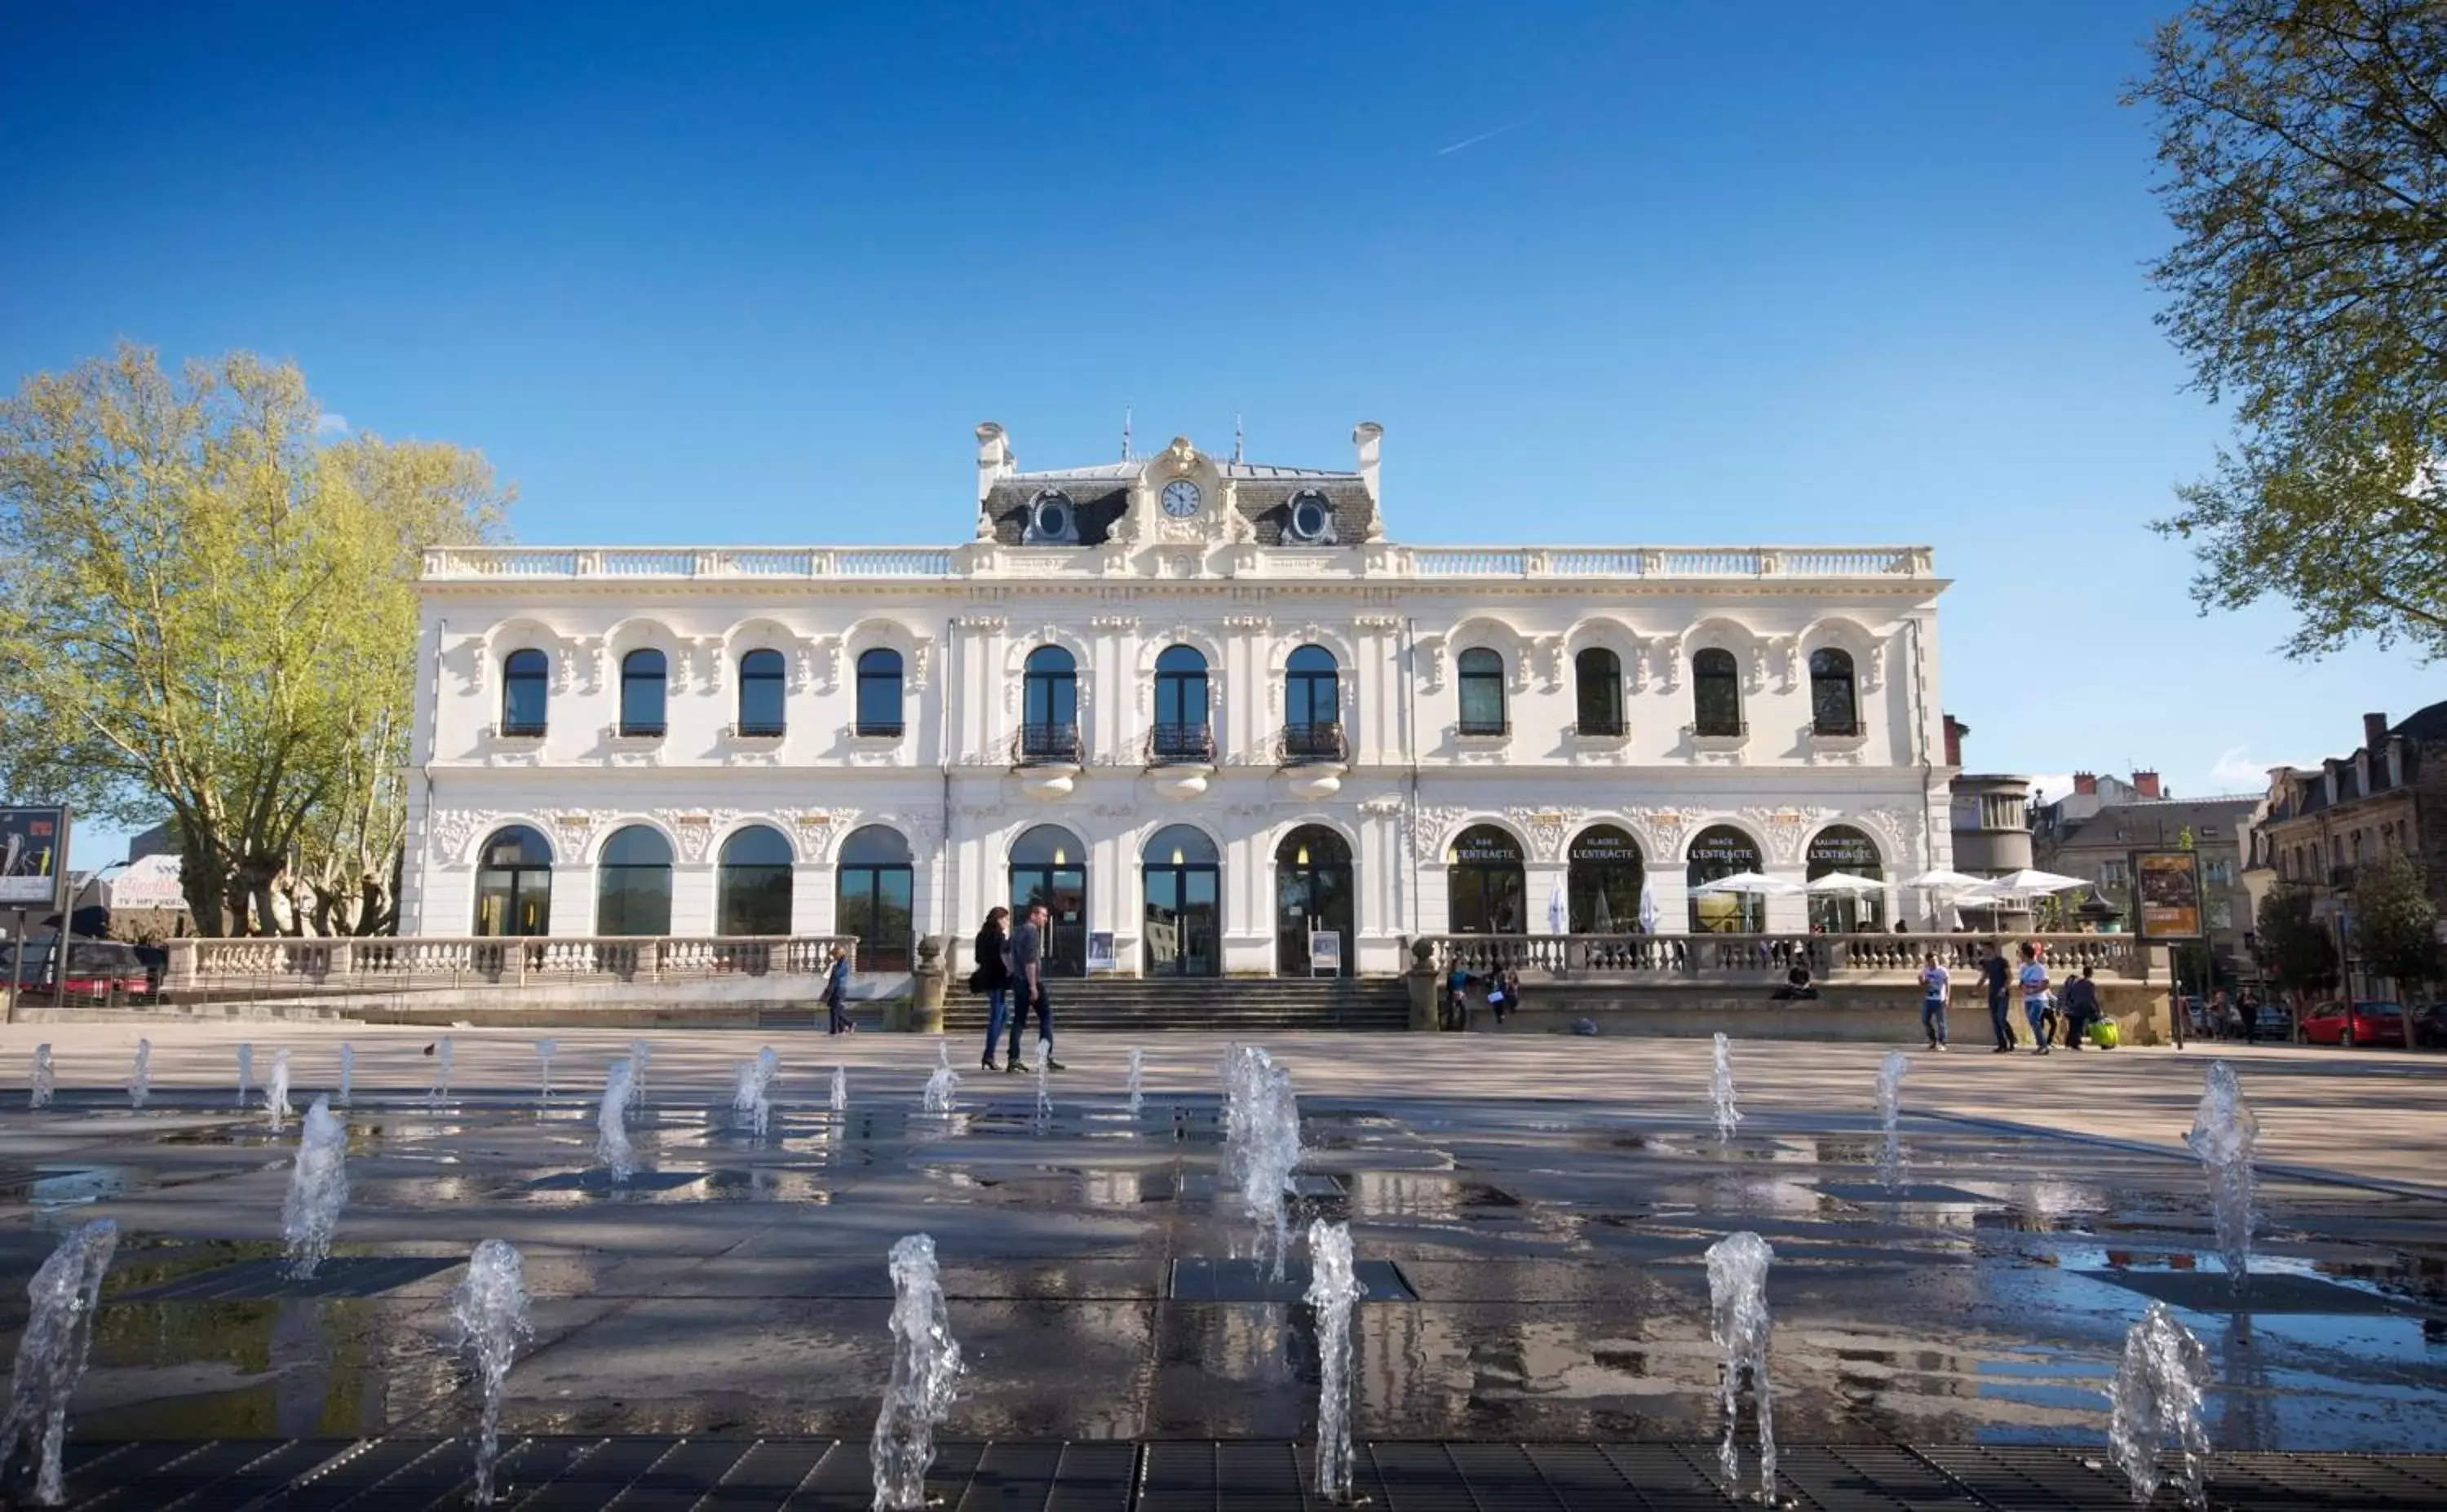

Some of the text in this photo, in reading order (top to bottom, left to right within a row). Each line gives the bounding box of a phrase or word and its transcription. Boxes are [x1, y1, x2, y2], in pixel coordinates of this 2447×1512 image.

[1573, 849, 1634, 859] L'ENTRACTE
[1691, 849, 1753, 859] L'ENTRACTE
[1810, 849, 1873, 859] L'ENTRACTE
